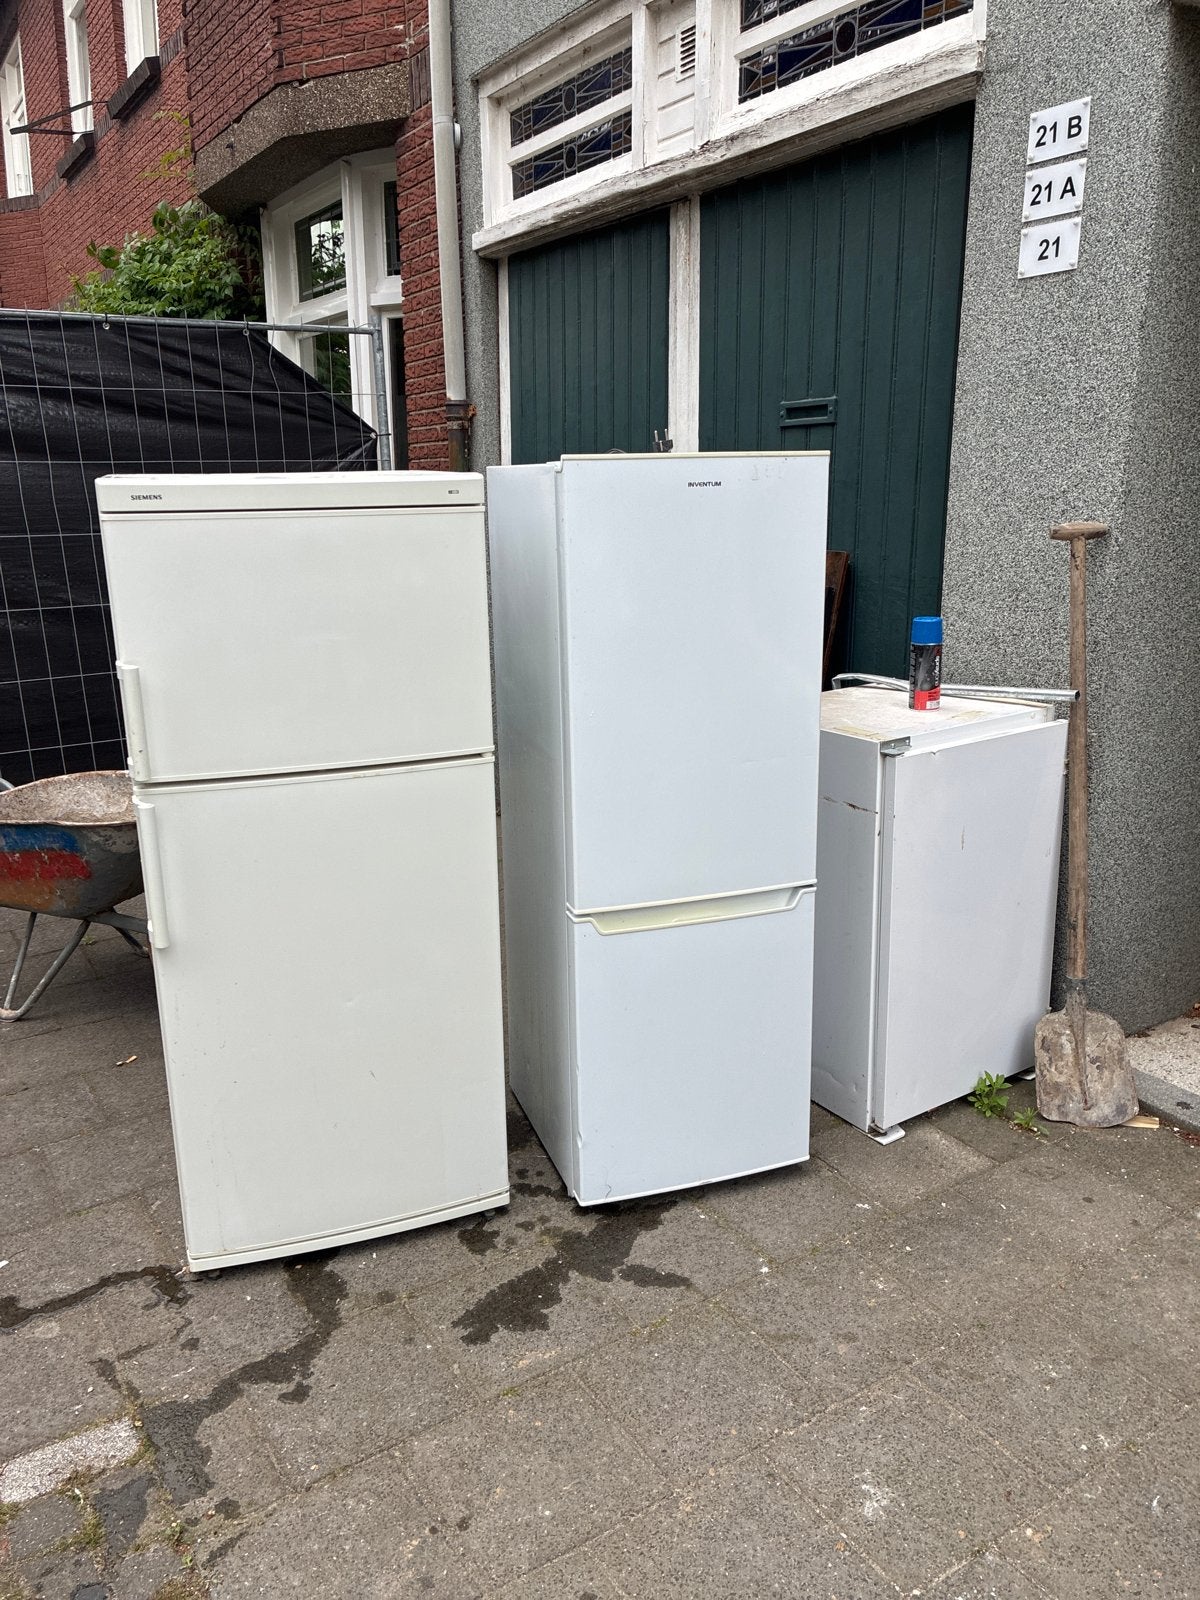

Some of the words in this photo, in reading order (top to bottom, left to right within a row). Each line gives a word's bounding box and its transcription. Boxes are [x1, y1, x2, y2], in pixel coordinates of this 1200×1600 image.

[1035, 121, 1058, 148] 21
[1067, 115, 1082, 139] B
[1030, 181, 1053, 206] 21
[1059, 176, 1076, 200] A
[1037, 236, 1061, 261] 21
